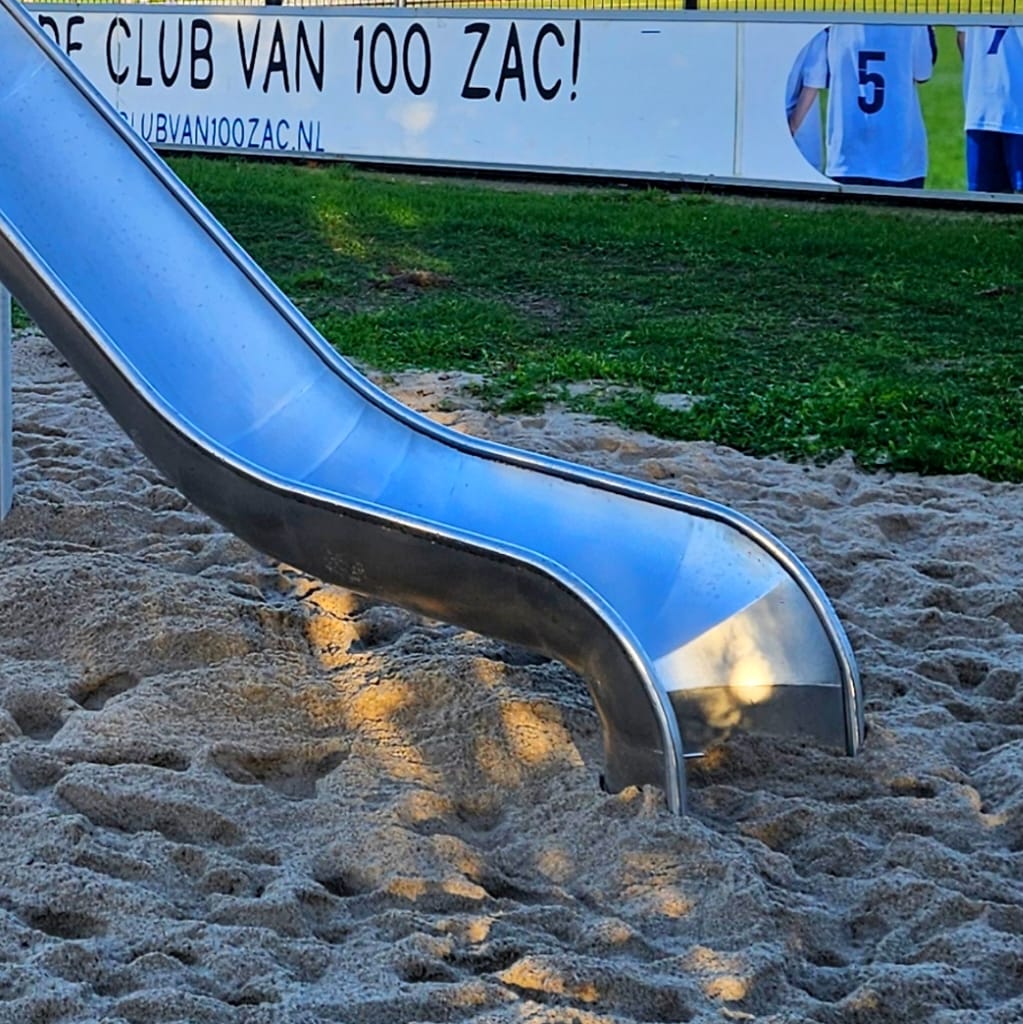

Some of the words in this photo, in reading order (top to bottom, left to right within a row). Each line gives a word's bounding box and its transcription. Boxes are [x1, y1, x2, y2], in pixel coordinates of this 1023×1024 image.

[106, 16, 214, 90] CLUB
[237, 18, 325, 94] VAN
[354, 22, 432, 96] 100
[461, 19, 581, 103] ZAC!
[857, 50, 886, 115] 5
